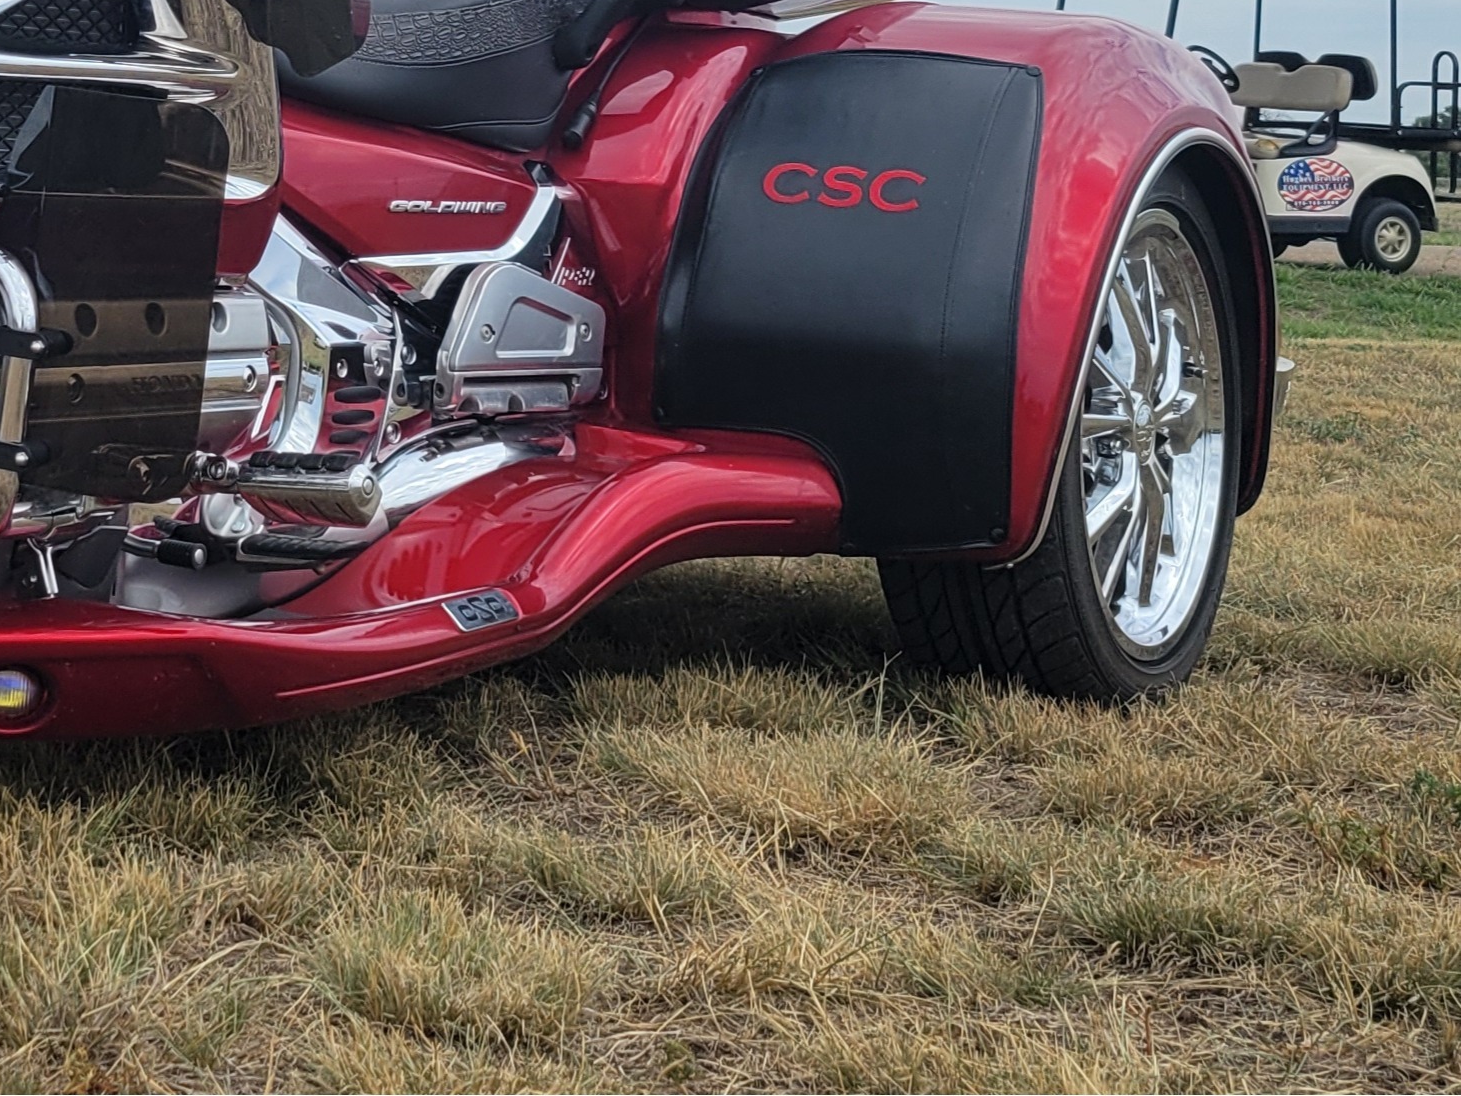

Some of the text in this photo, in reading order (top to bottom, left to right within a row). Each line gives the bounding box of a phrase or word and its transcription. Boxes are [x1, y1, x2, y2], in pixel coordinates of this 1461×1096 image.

[762, 161, 928, 213] CSC
[389, 200, 508, 214] GOLDWING
[457, 596, 506, 622] CSC
